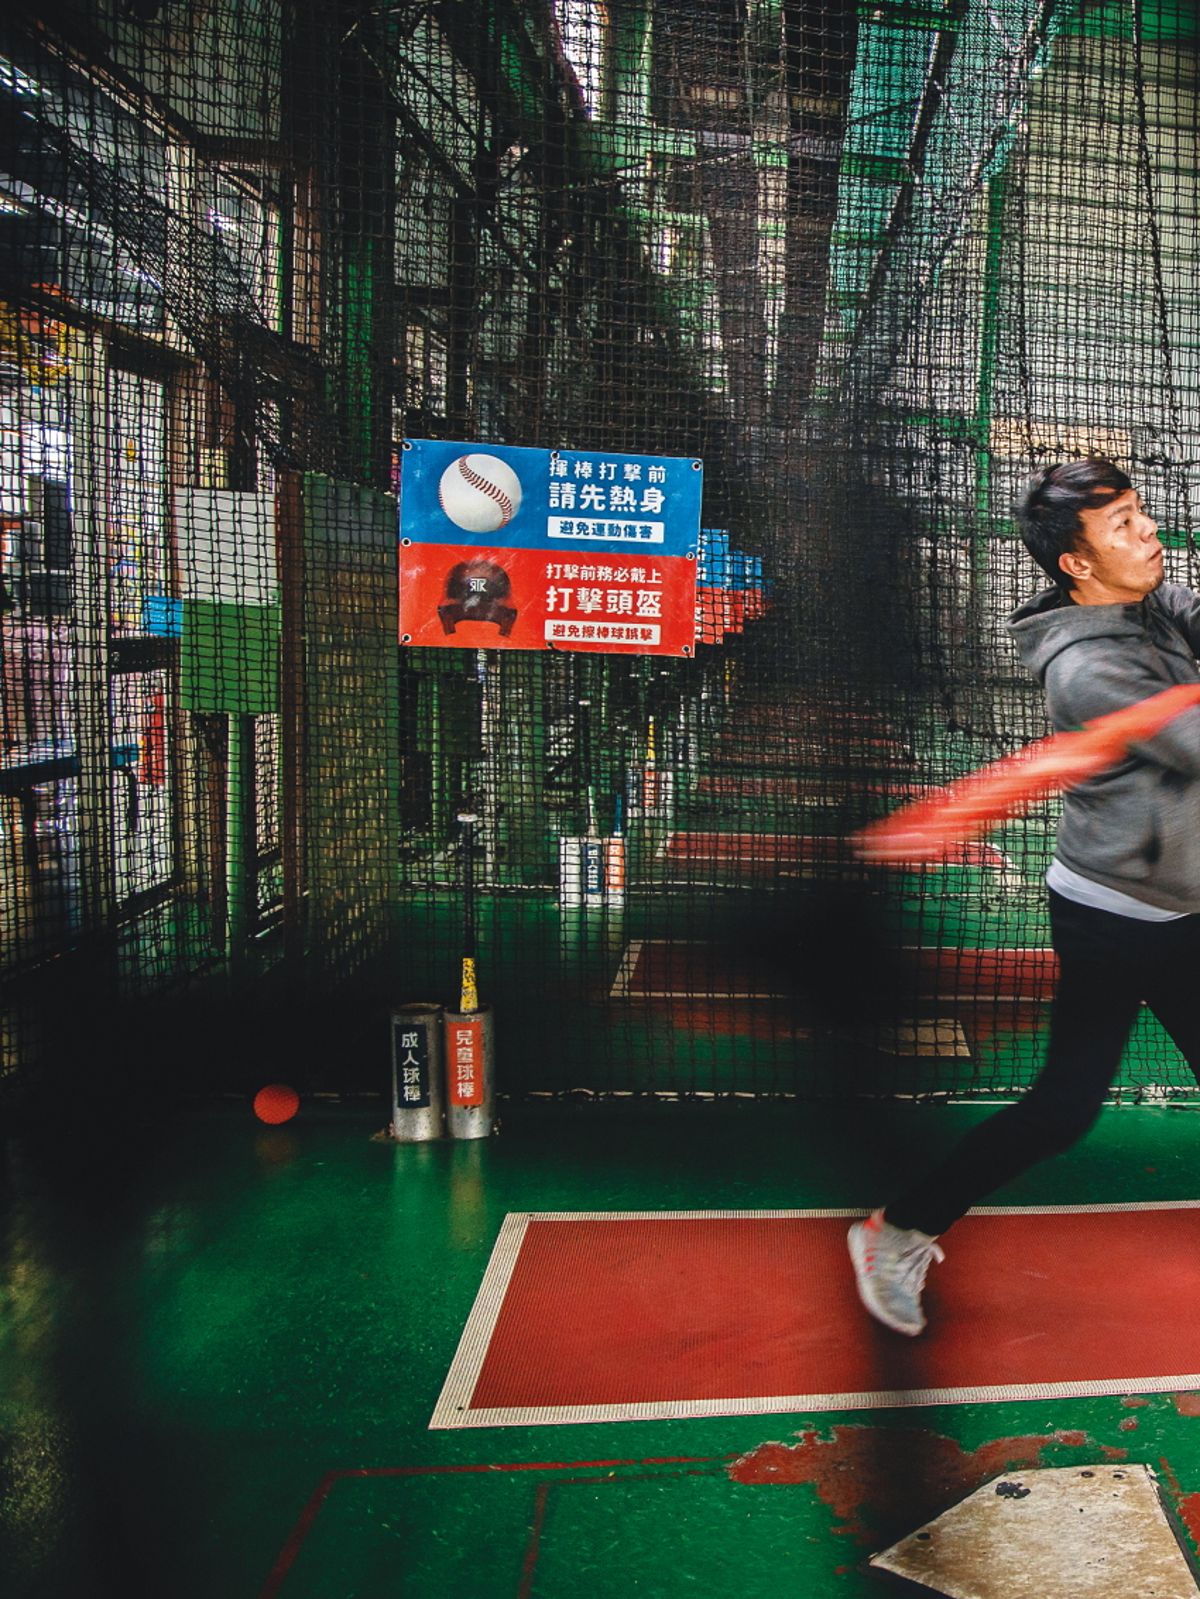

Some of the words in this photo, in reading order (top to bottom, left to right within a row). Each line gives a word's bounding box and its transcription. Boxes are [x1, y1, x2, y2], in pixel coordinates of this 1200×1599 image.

[549, 459, 666, 483] 揮棒打擊前
[549, 482, 665, 513] 請先熱身
[558, 520, 654, 540] 避免運動傷害
[545, 562, 663, 585] 打擊前務必戴上
[545, 585, 663, 618] 打擊頭盔
[551, 623, 654, 642] 避免擦棒球誤擊
[401, 1032, 421, 1102] 成人球棒
[455, 1030, 475, 1098] 兒童球棒
